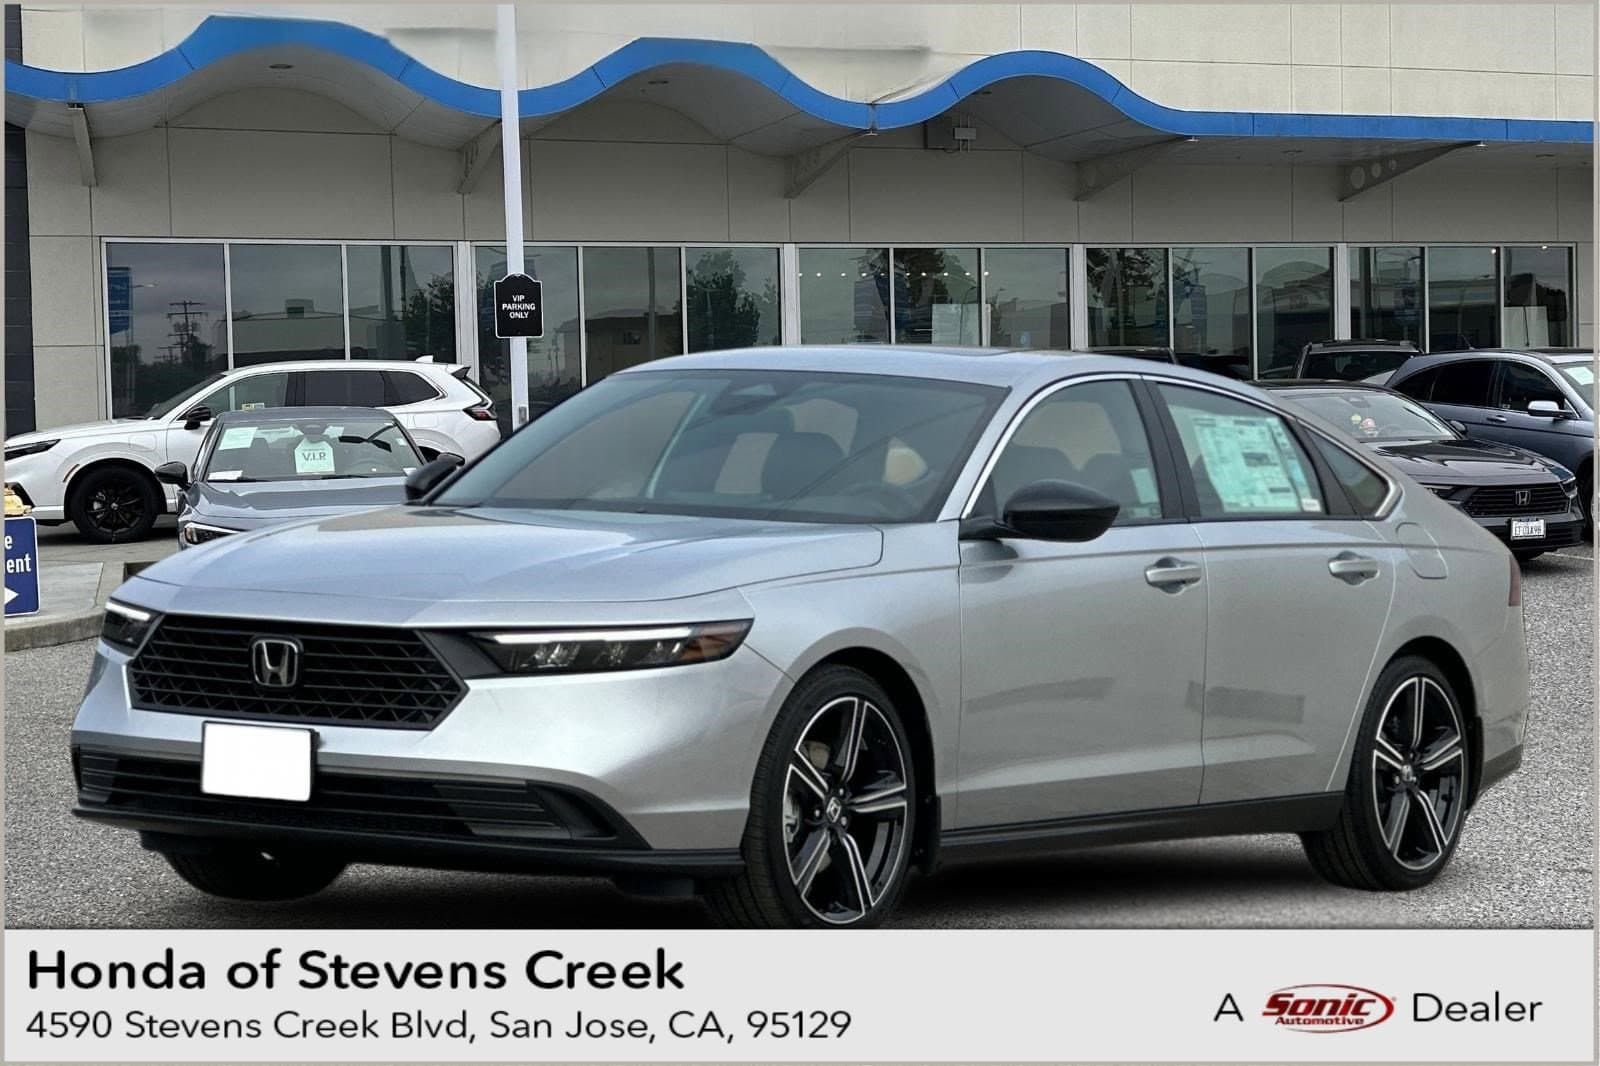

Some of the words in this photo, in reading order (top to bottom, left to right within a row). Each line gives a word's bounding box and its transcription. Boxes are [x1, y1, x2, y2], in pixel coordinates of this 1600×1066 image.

[512, 294, 525, 302] VIP
[502, 303, 536, 311] PARKING
[509, 311, 529, 319] ONLY
